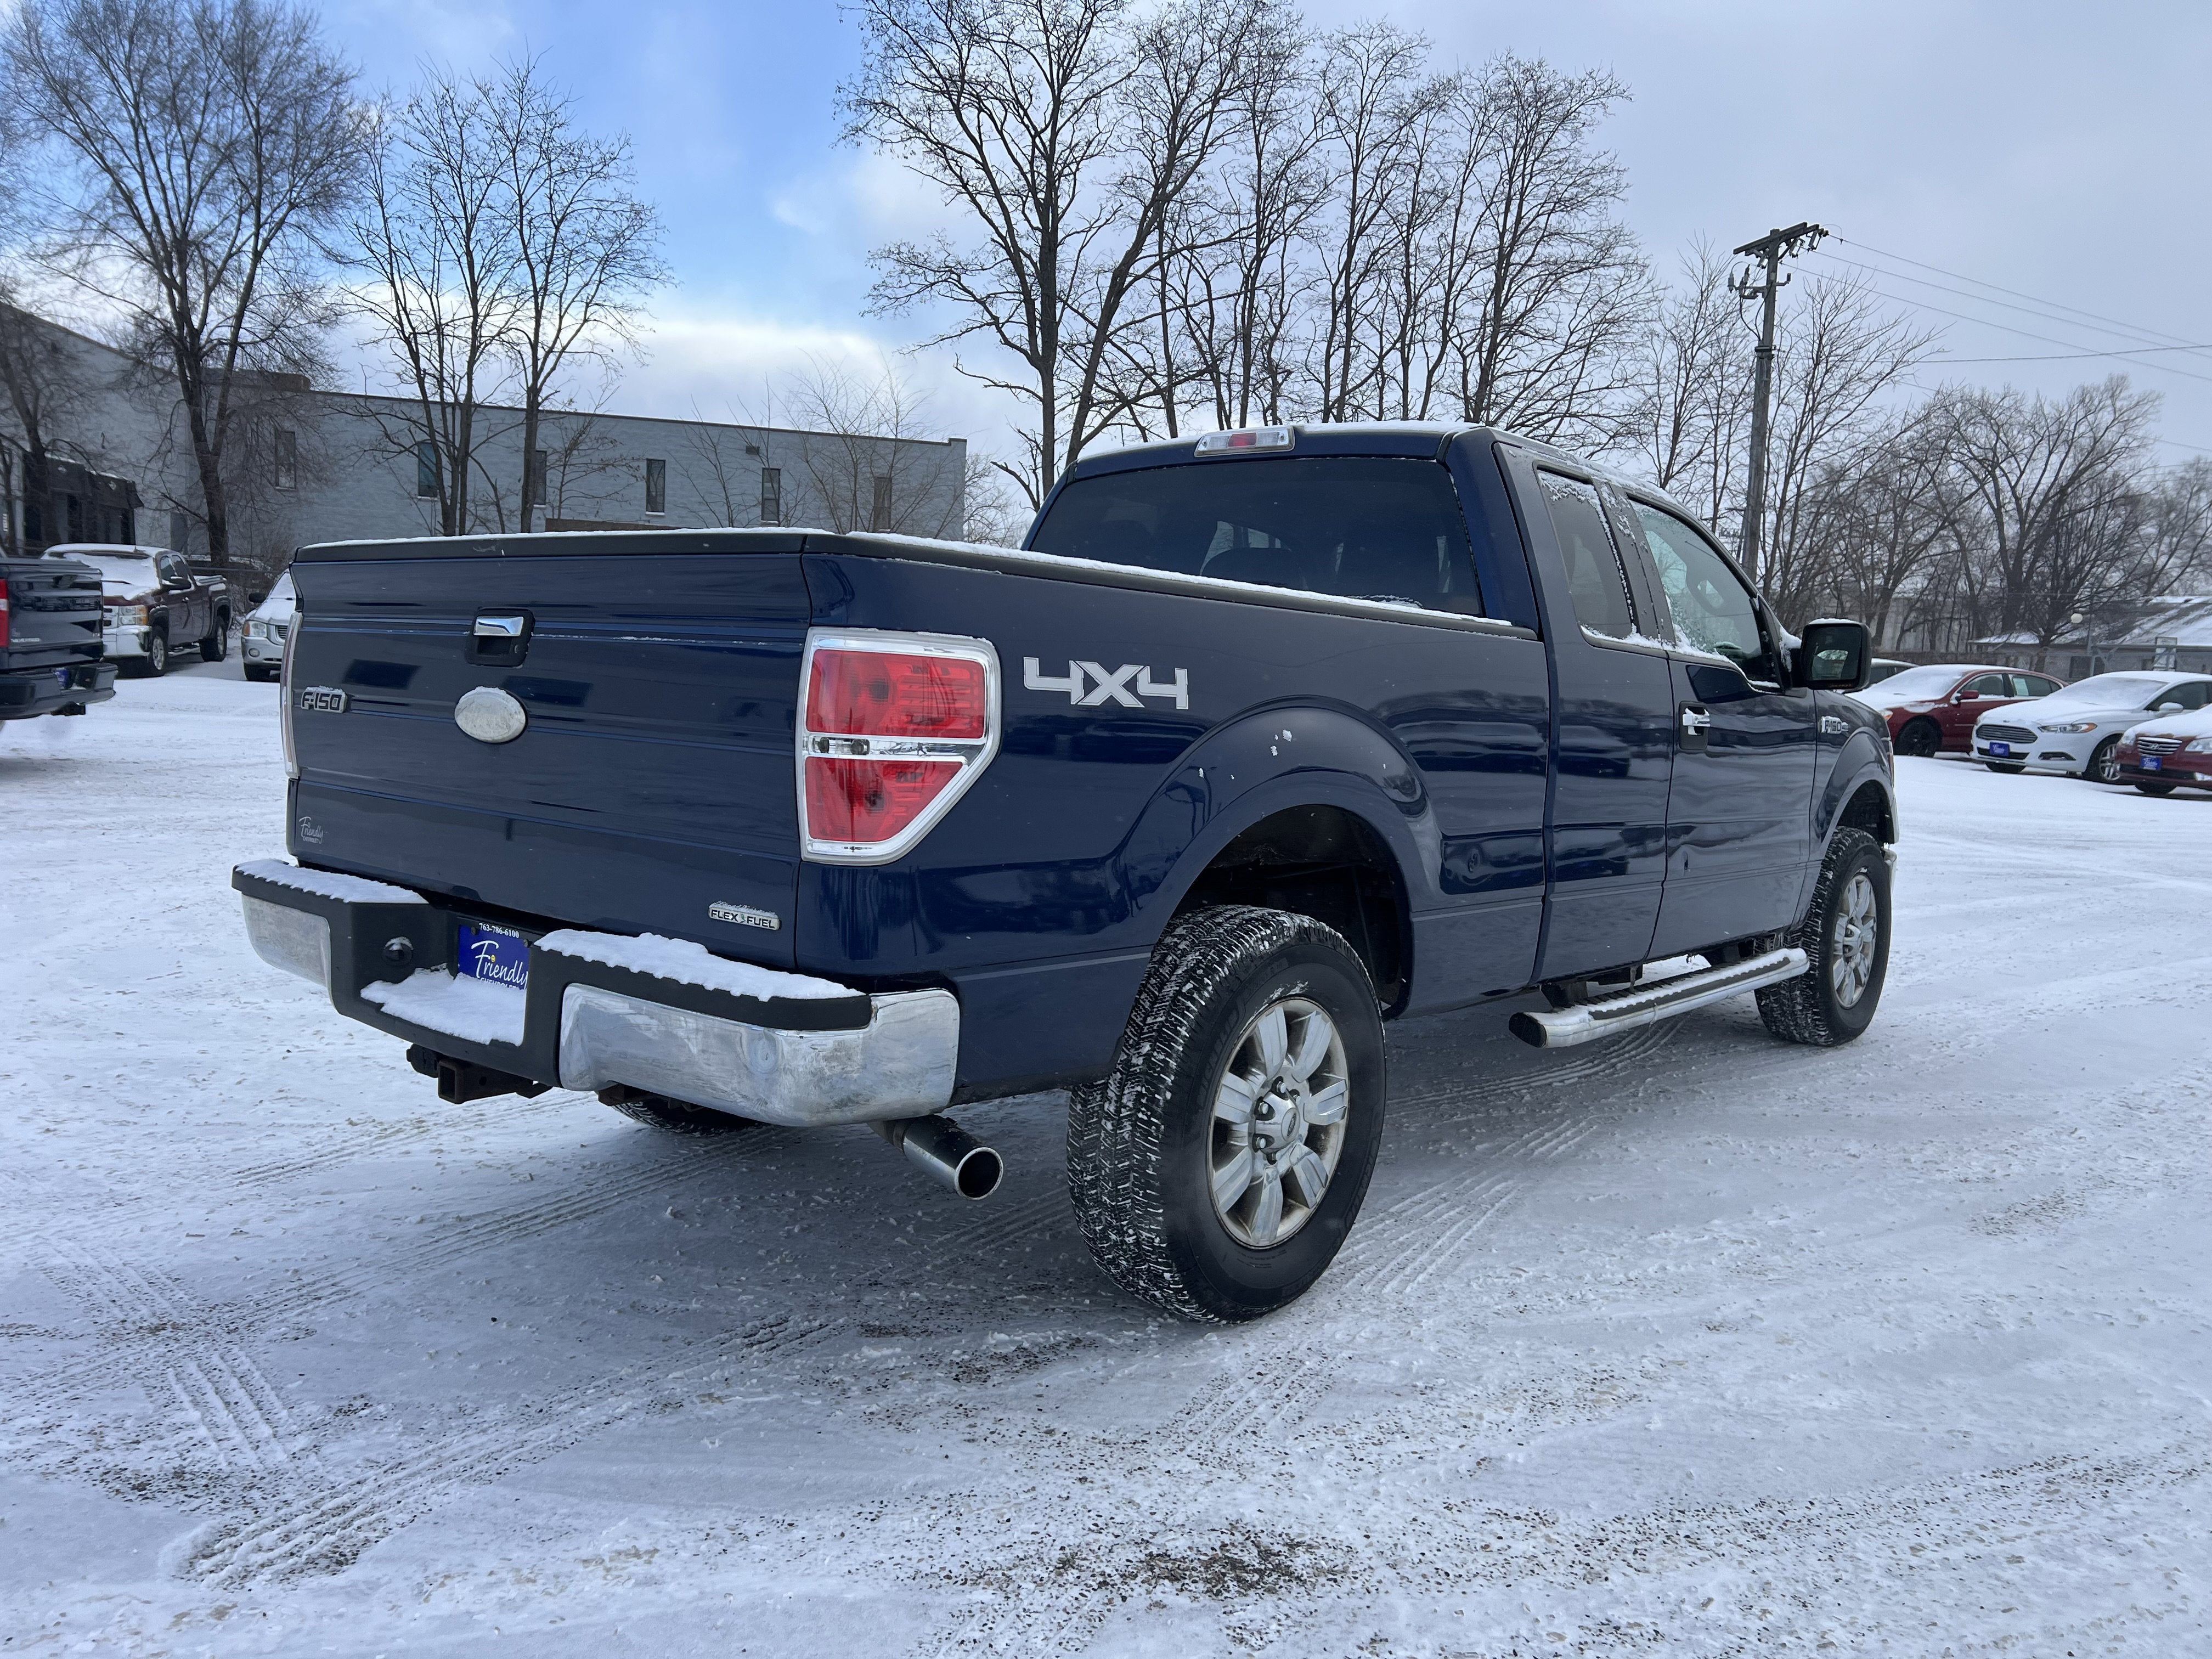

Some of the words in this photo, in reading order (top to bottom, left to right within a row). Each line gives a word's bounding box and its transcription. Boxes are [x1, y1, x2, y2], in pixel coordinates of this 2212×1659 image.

[1023, 656, 1189, 710] 4X4
[302, 691, 342, 711] F-150
[1824, 720, 1842, 732] F-150
[298, 816, 324, 844] Friendly
[711, 909, 739, 922] FLEX
[746, 915, 776, 929] FUEL
[478, 922, 520, 939] 763-786-6100
[470, 940, 529, 990] Friendly
